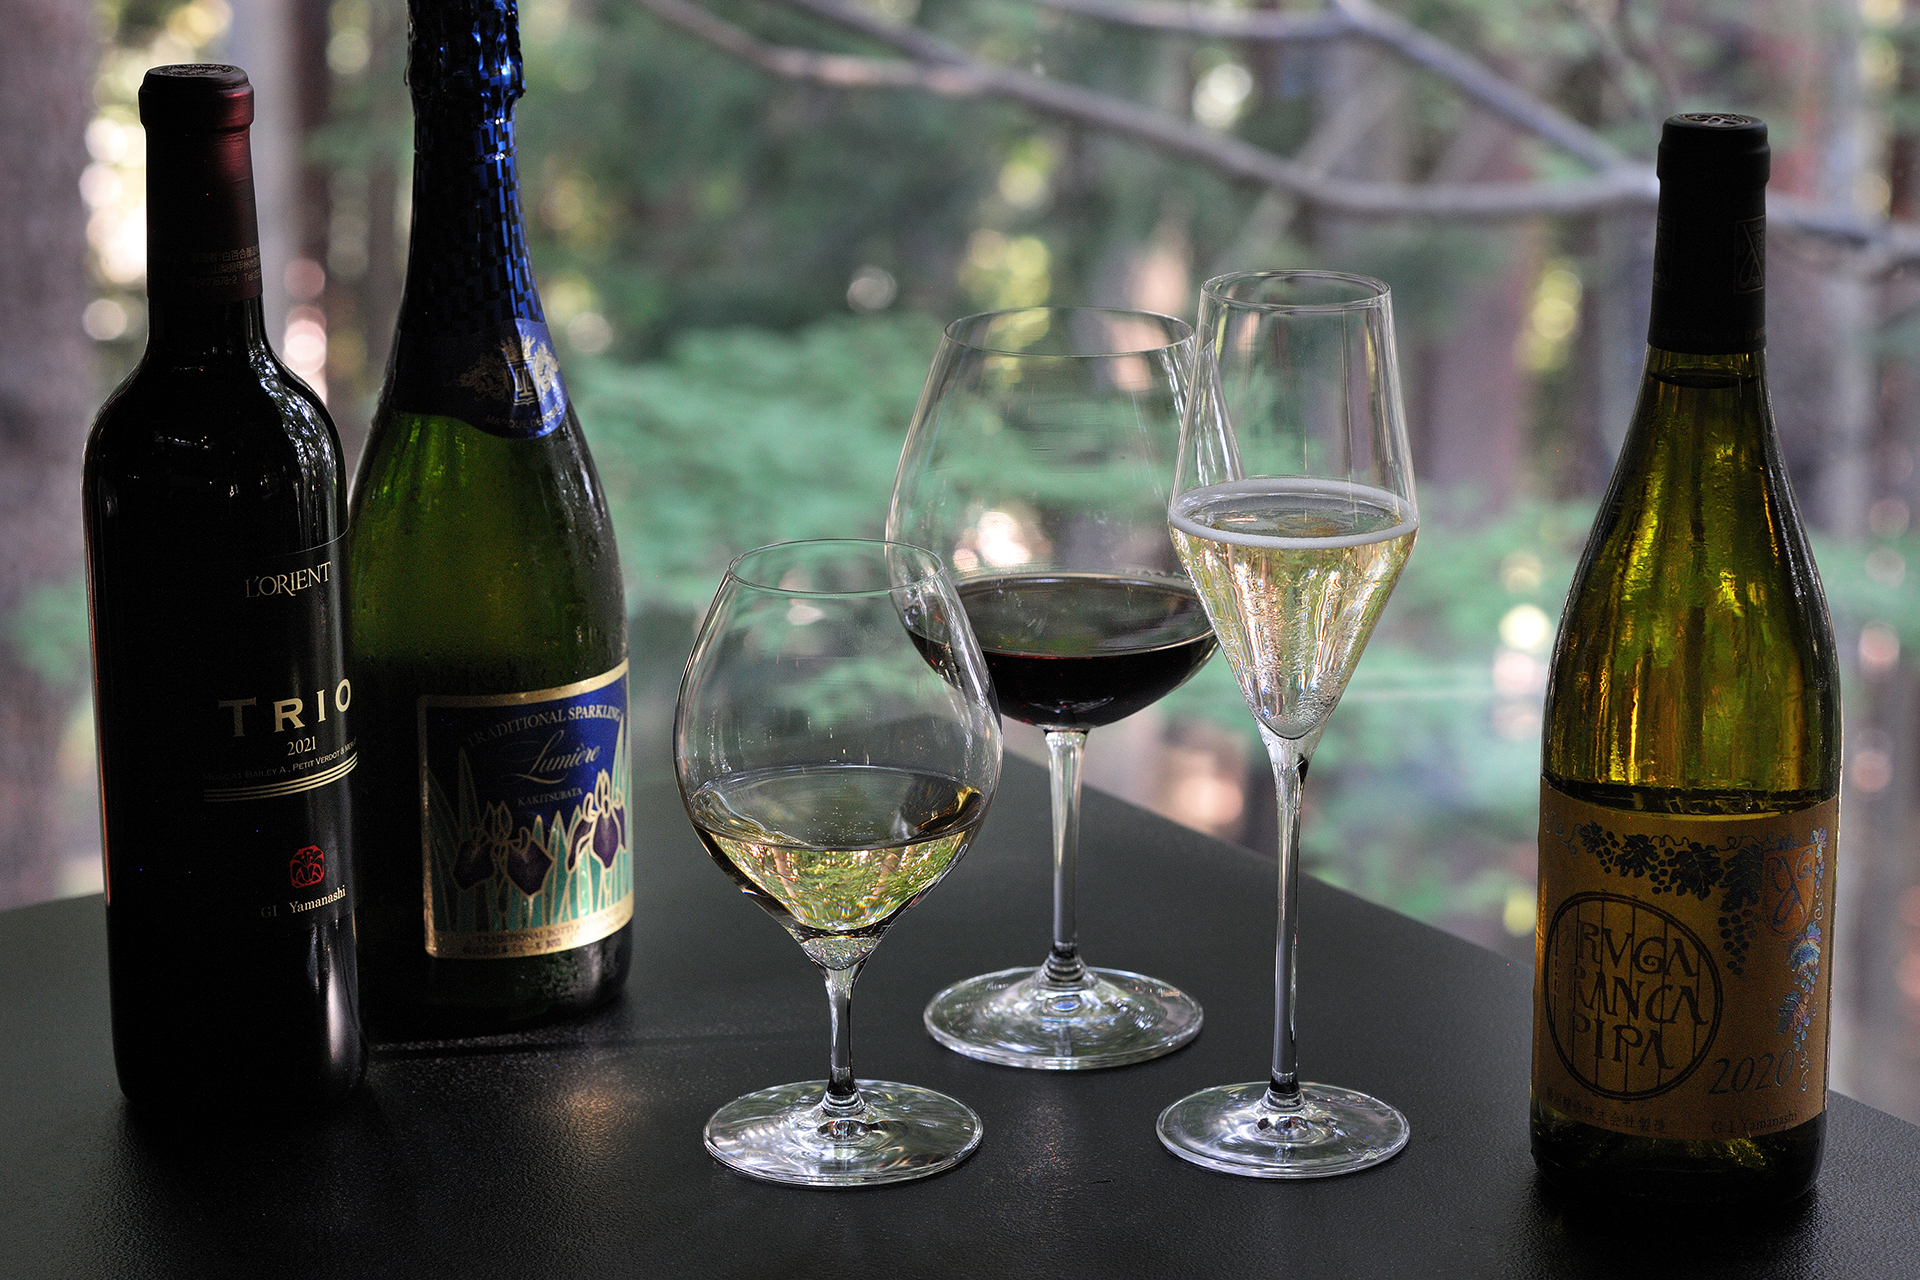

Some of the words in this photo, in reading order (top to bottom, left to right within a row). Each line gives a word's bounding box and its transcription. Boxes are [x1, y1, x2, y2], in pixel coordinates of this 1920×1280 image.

[244, 561, 332, 598] L'ORIENT
[217, 678, 352, 737] TRIO
[467, 709, 566, 748] TRADITIONAL
[568, 704, 622, 722] SPARKLING
[286, 735, 317, 757] 2021
[503, 729, 601, 785] Lumière
[517, 787, 583, 807] KAKITSUBATA
[261, 905, 279, 920] GI
[289, 885, 347, 914] Yamanashi
[1567, 1008, 1674, 1070] PIPA
[1708, 1049, 1794, 1096] 2020
[1740, 1110, 1798, 1132] Yamanashi
